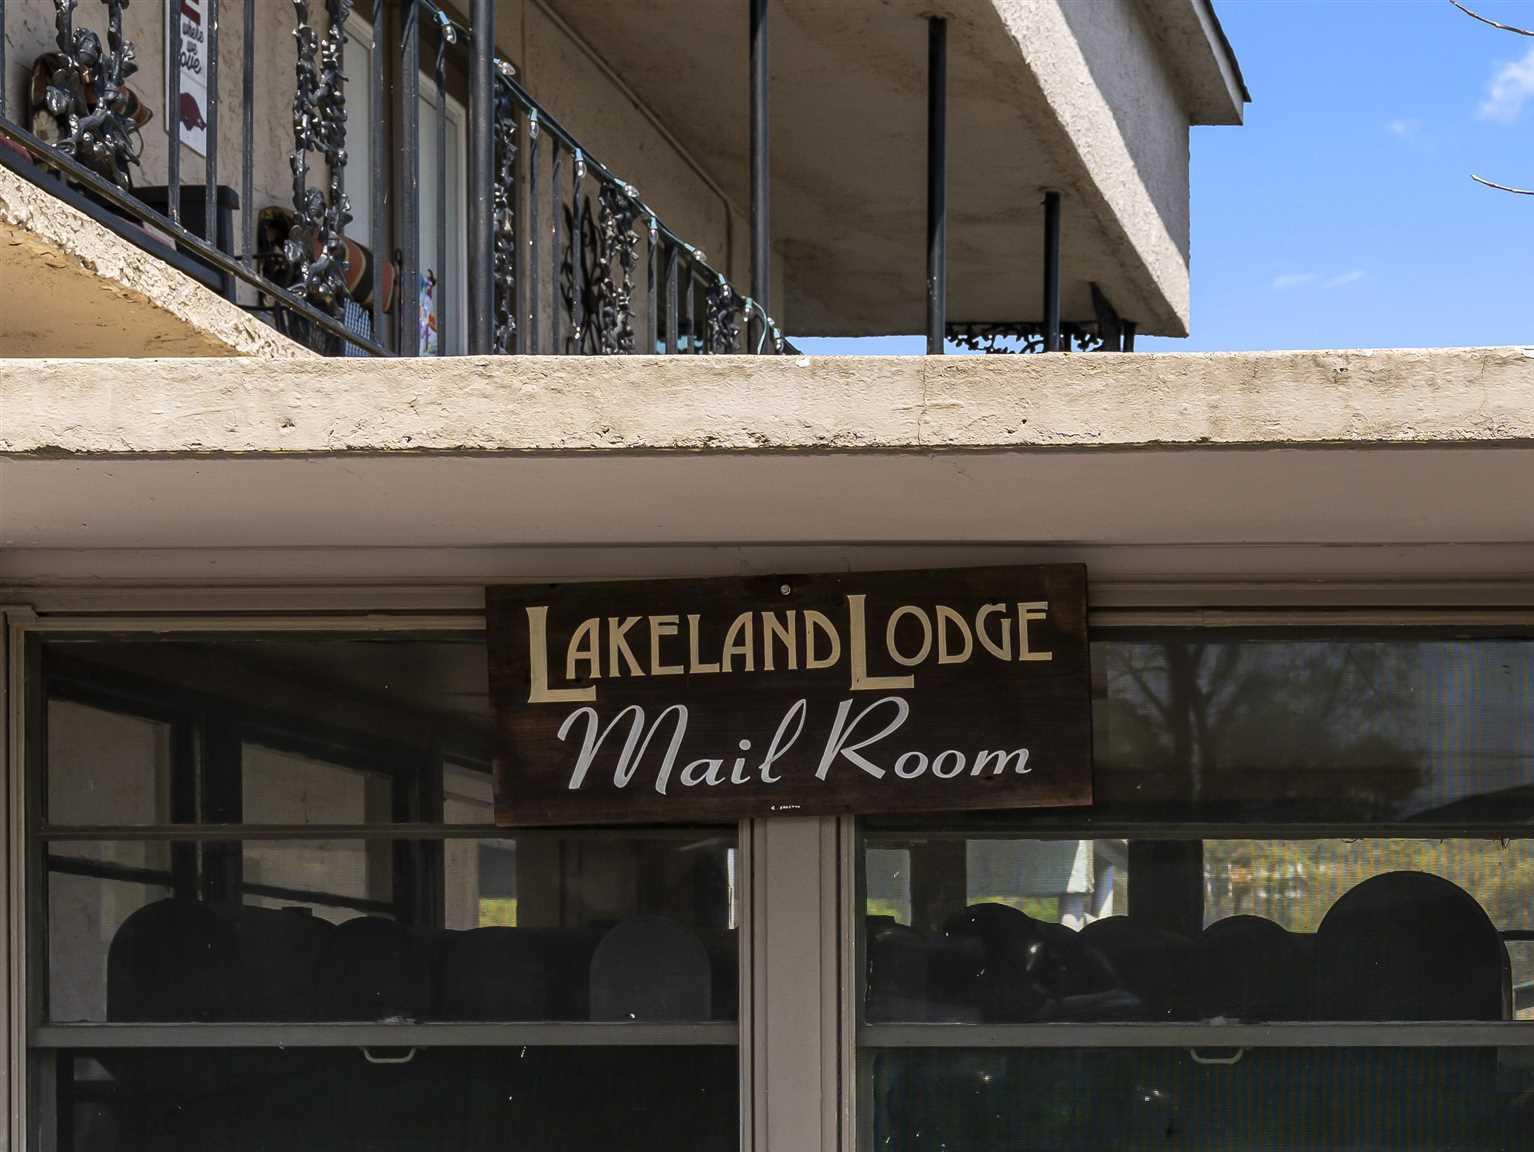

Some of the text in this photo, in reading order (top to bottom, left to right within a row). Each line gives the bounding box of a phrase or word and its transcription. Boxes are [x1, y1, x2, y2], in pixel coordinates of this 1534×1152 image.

[526, 594, 1053, 703] LAKELAND LODGE
[557, 696, 1032, 795] Mail Room
